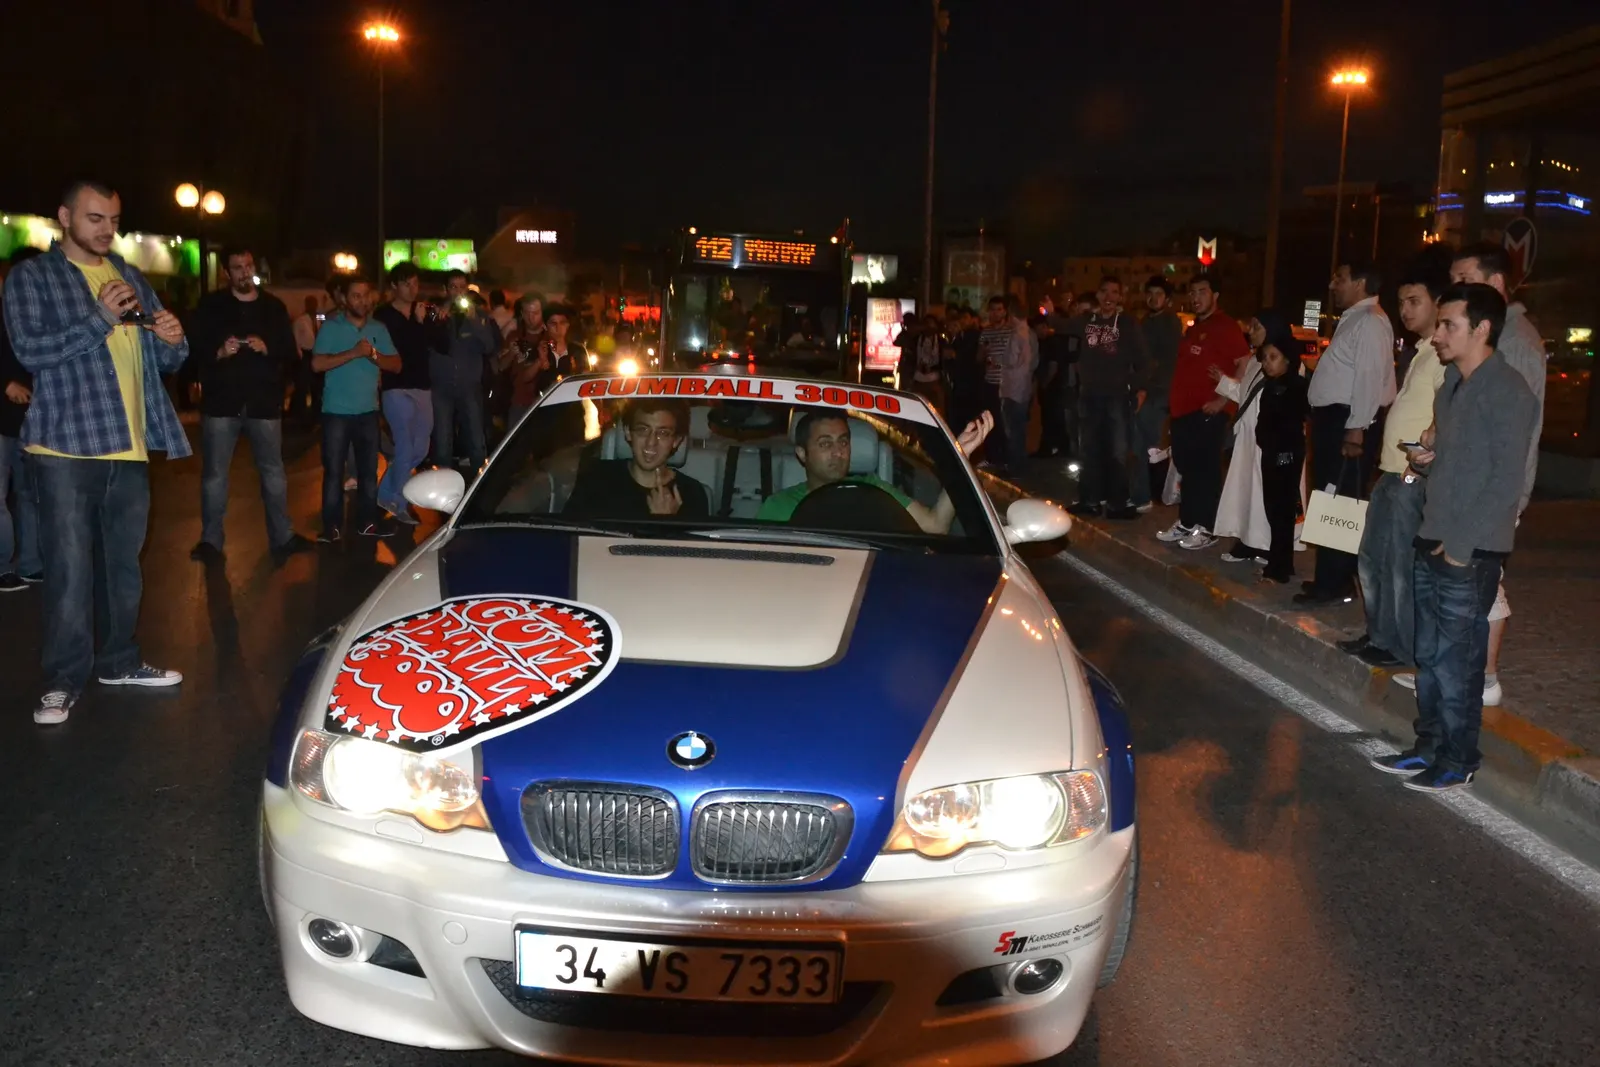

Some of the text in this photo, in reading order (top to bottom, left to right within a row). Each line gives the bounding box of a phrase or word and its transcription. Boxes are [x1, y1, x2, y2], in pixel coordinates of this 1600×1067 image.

[515, 229, 558, 244] NEVER HIDE
[695, 236, 733, 260] 112
[577, 377, 902, 414] GUMBALL 3000
[1320, 514, 1359, 531] IPEKYOL
[553, 943, 830, 999] 34 VS 7333
